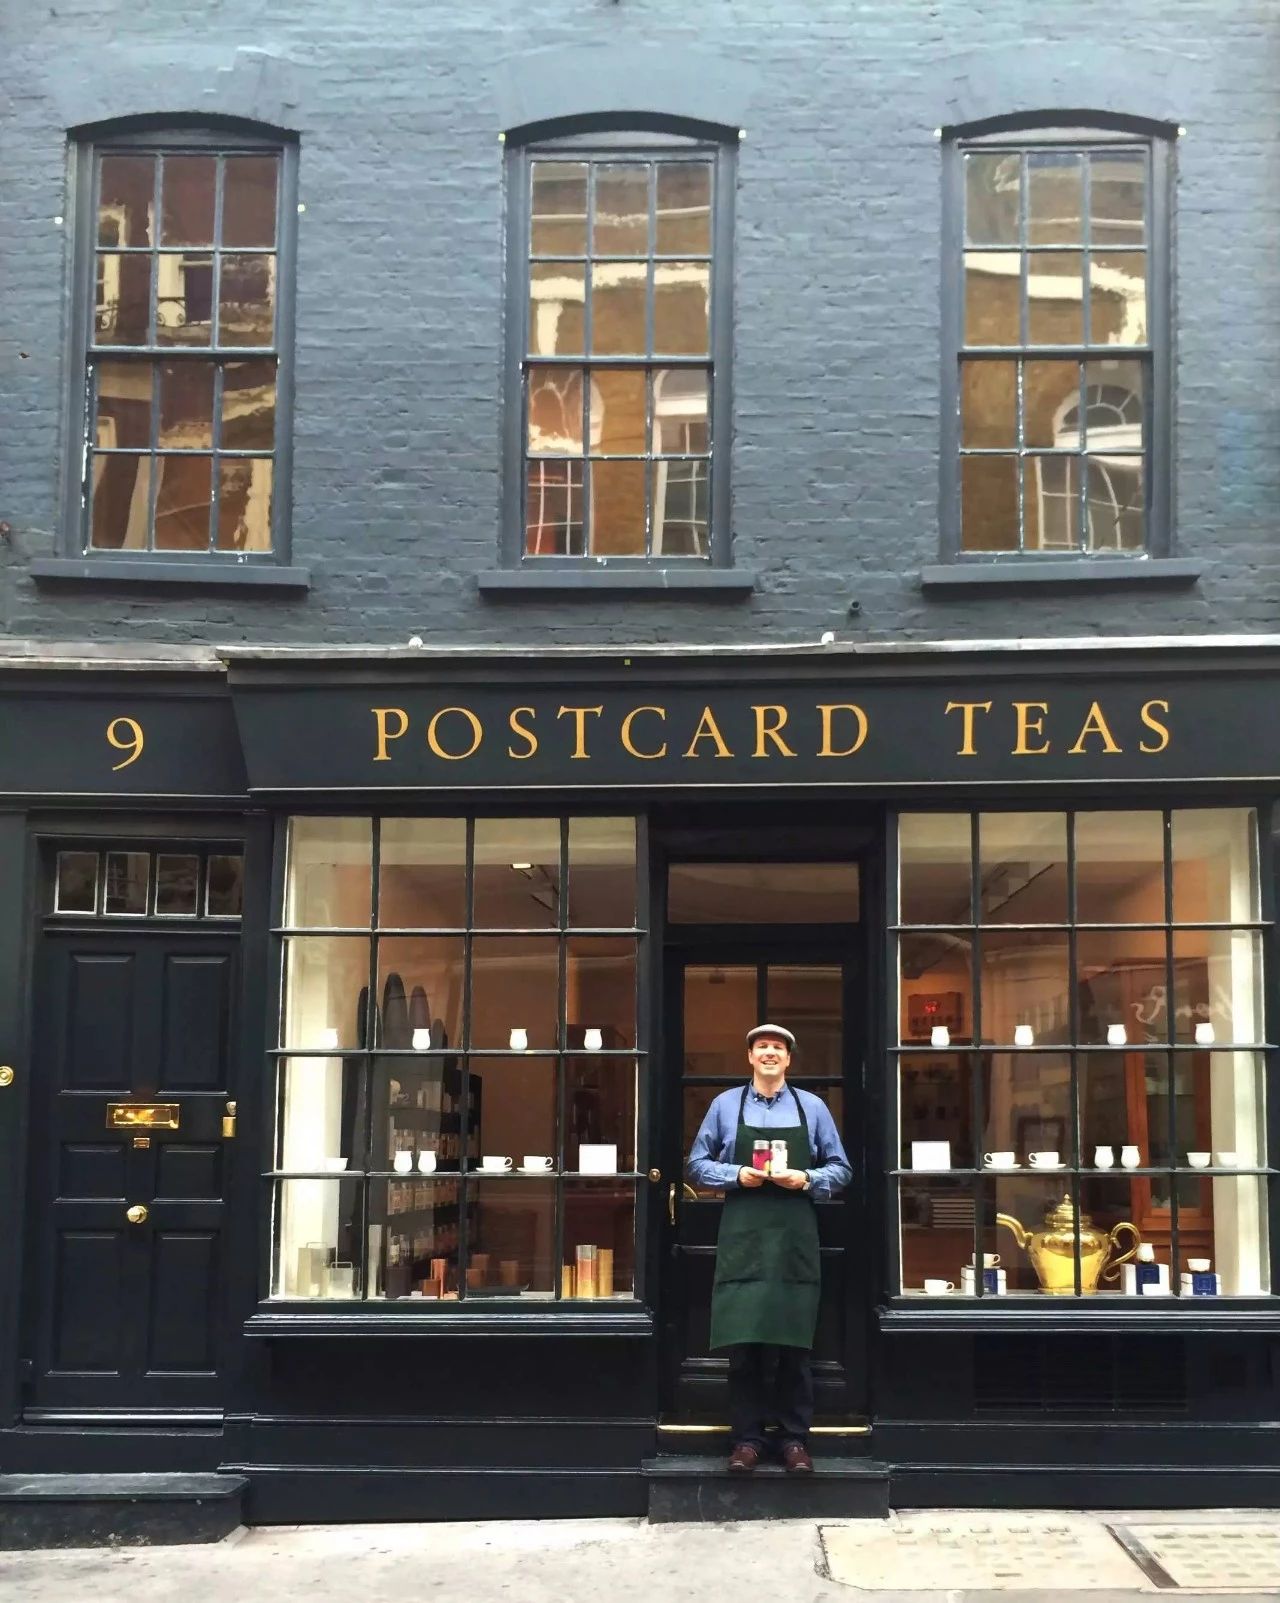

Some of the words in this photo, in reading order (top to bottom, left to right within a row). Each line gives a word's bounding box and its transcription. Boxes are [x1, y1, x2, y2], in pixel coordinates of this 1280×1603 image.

[106, 717, 144, 770] 9
[371, 703, 869, 762] POSTCARD
[945, 699, 1171, 756] TEAS
